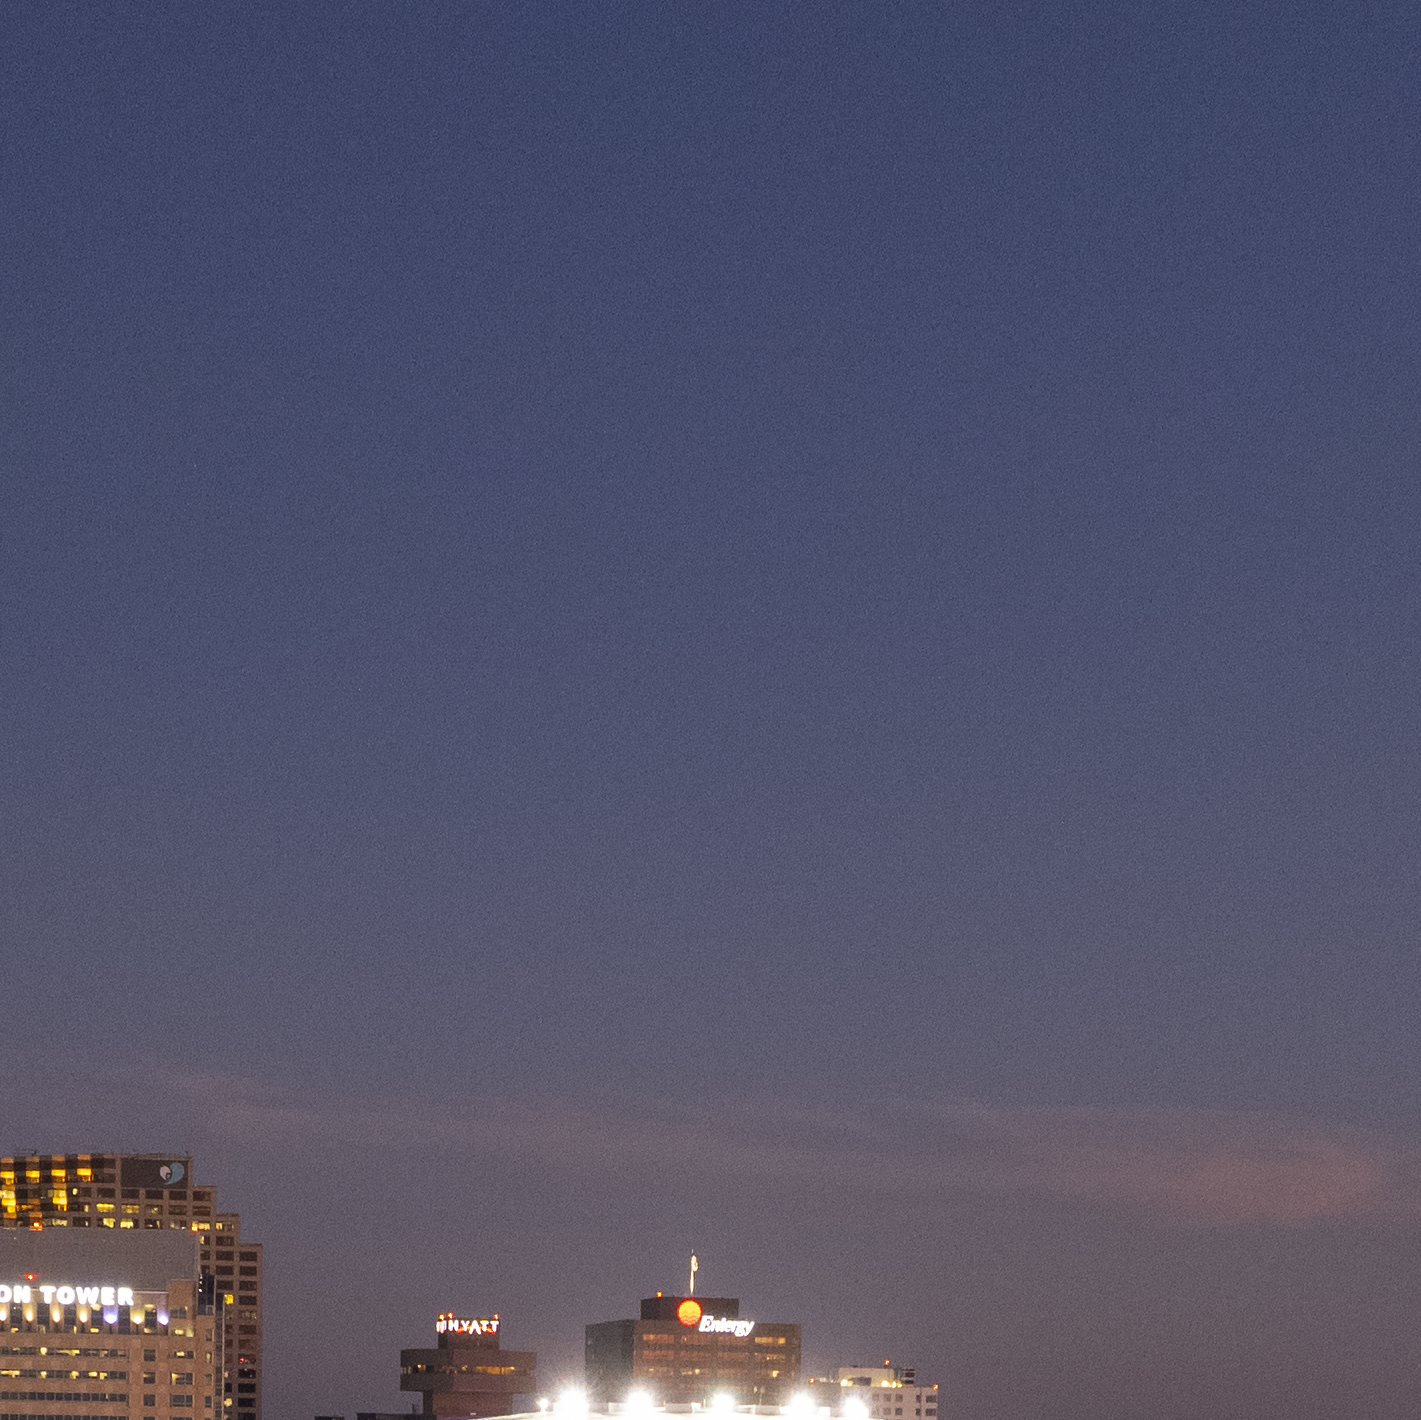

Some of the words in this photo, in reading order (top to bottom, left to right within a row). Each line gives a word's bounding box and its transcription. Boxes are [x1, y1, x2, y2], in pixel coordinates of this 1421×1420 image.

[39, 1286, 135, 1306] TOWER
[447, 1319, 500, 1335] HYATT
[698, 1315, 755, 1337] Entergy
